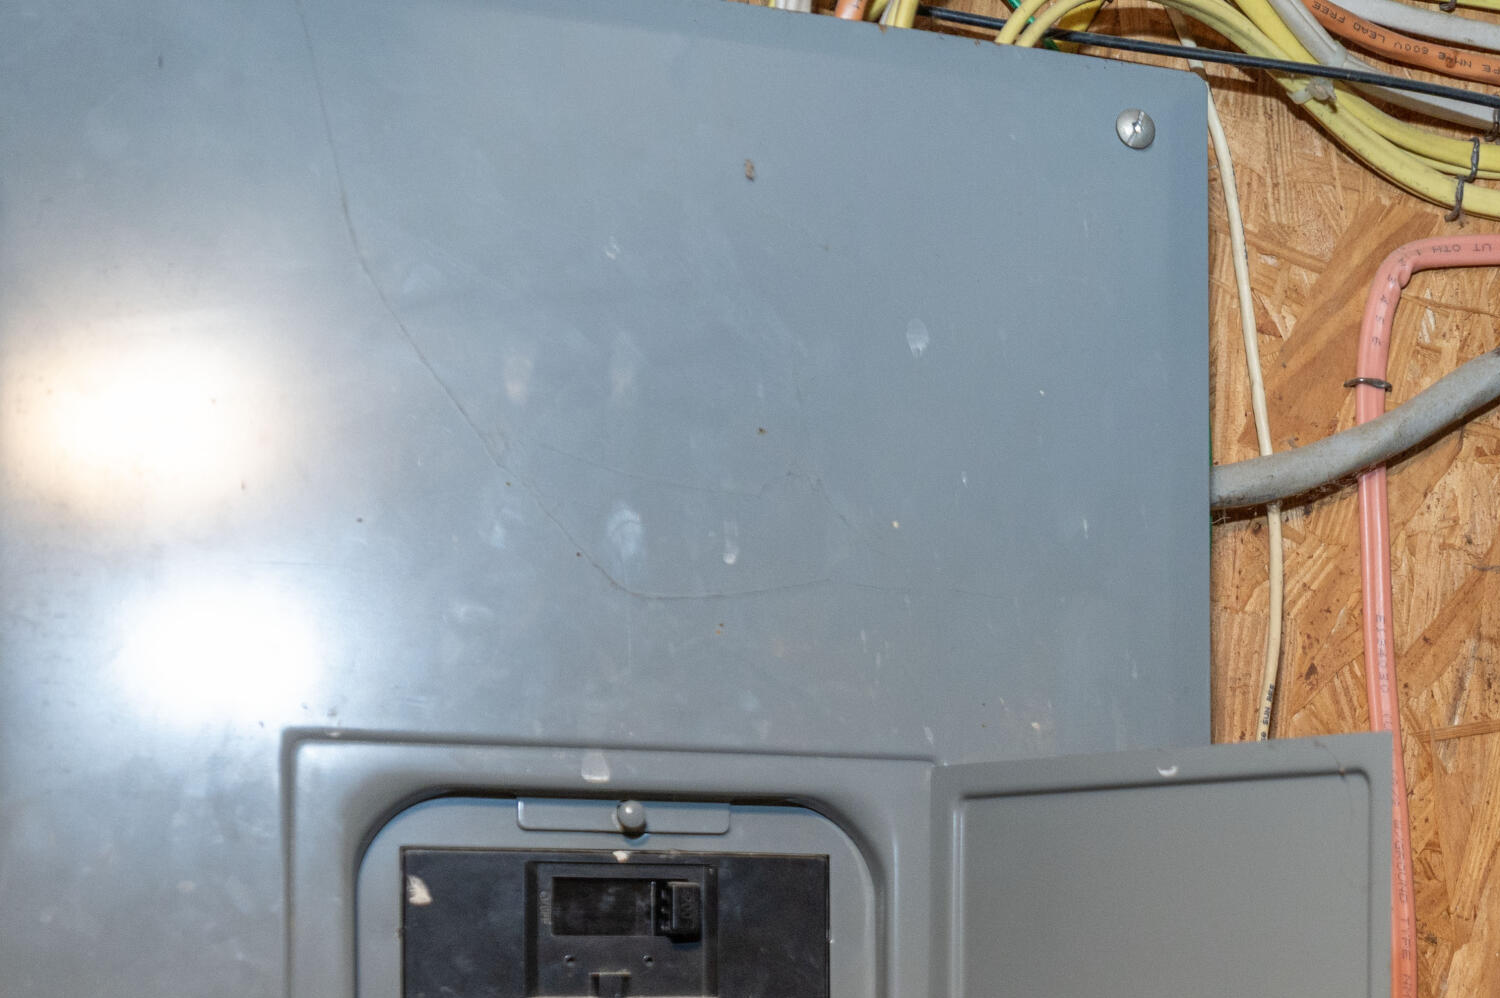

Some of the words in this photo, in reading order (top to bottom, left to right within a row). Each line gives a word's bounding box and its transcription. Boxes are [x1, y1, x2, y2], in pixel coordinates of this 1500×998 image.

[1311, 0, 1346, 24] FREE
[1353, 21, 1386, 44] LEAD
[1394, 41, 1430, 55] 600V
[1432, 244, 1462, 255] OTH
[1472, 242, 1493, 253] UT
